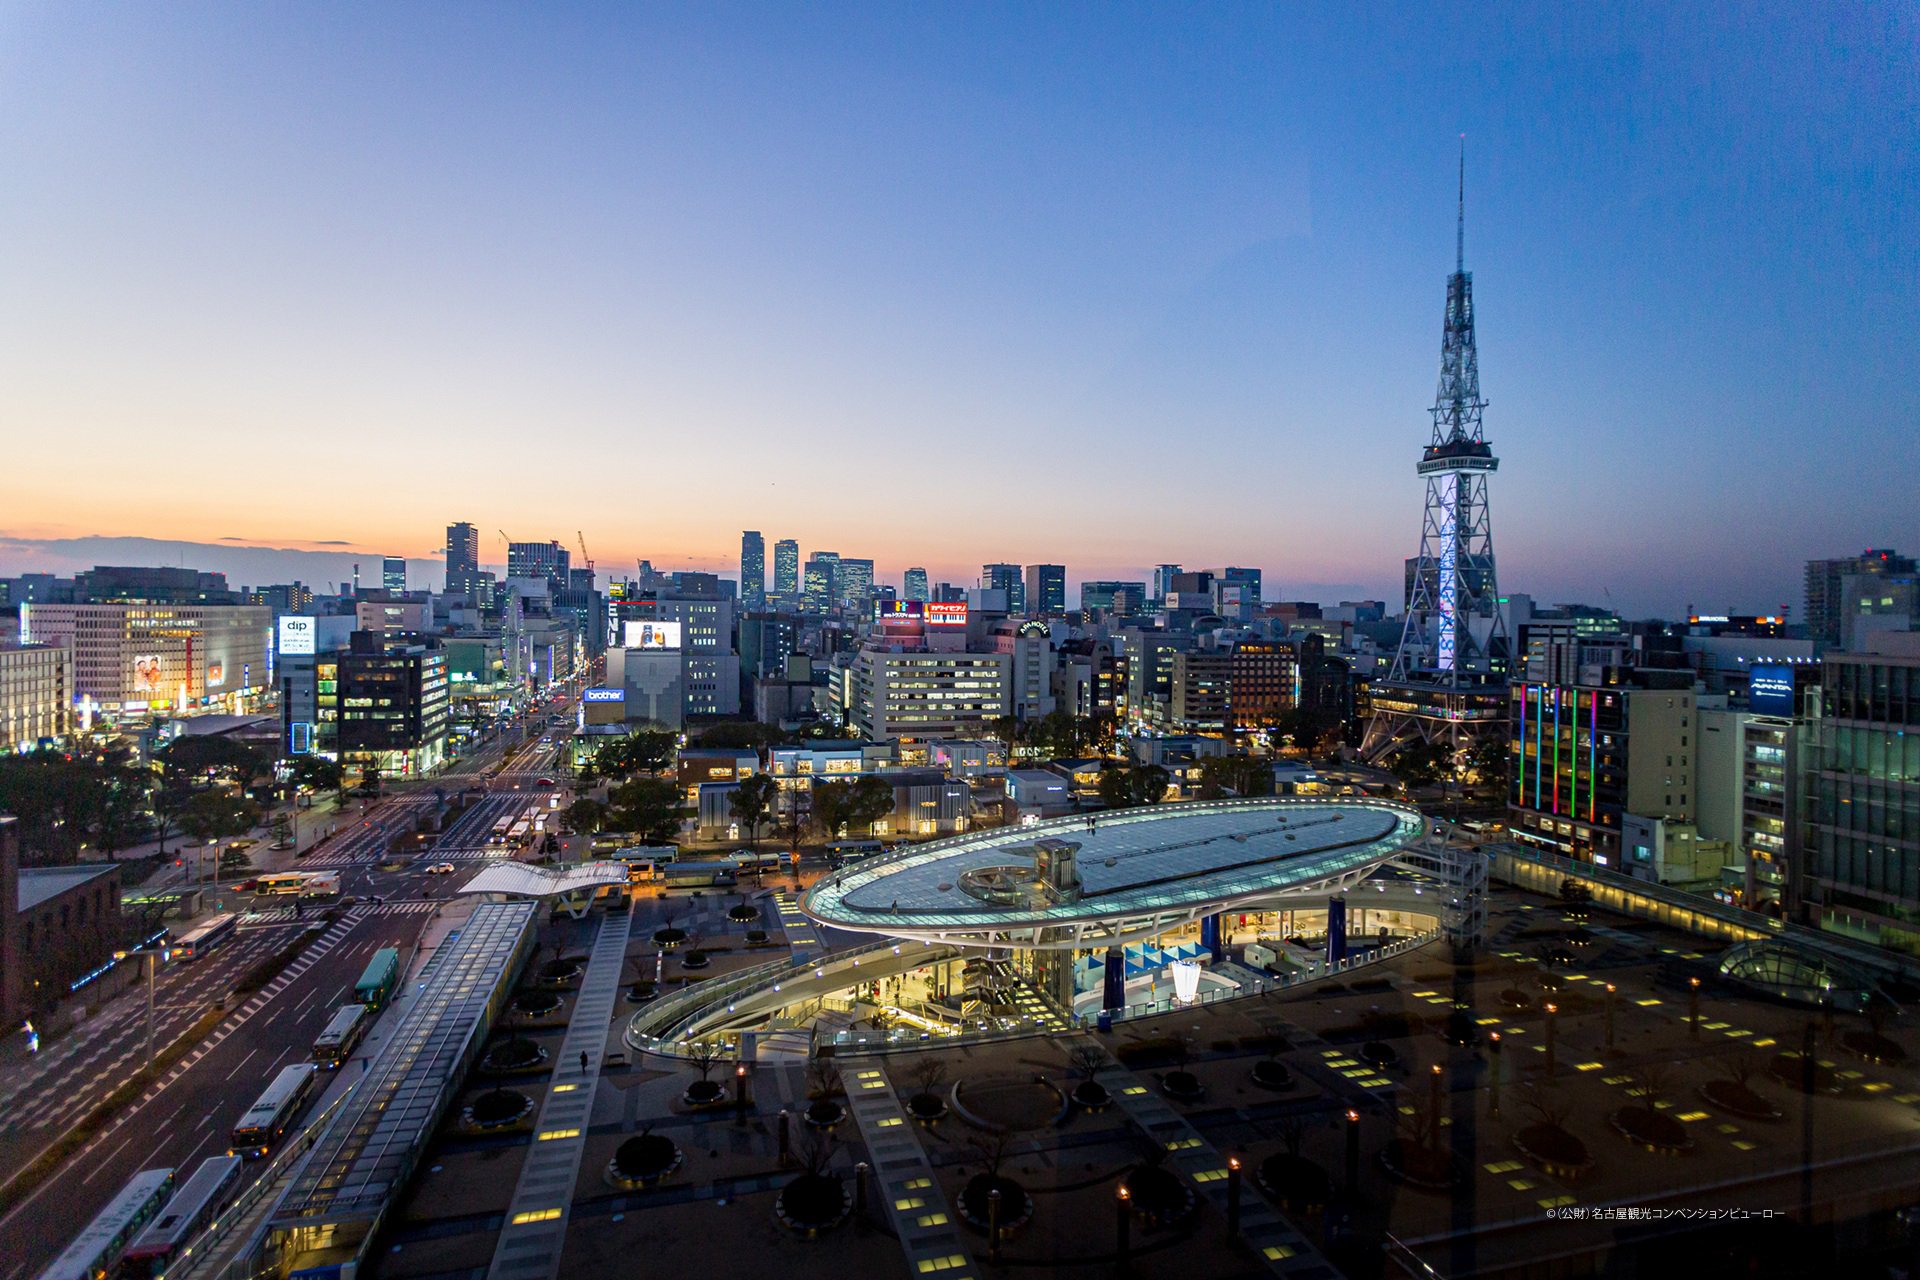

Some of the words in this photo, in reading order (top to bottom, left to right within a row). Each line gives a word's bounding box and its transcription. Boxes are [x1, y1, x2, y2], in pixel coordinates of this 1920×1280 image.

[287, 621, 307, 631] dip
[1031, 621, 1049, 634] HOTEL
[588, 691, 621, 699] brother
